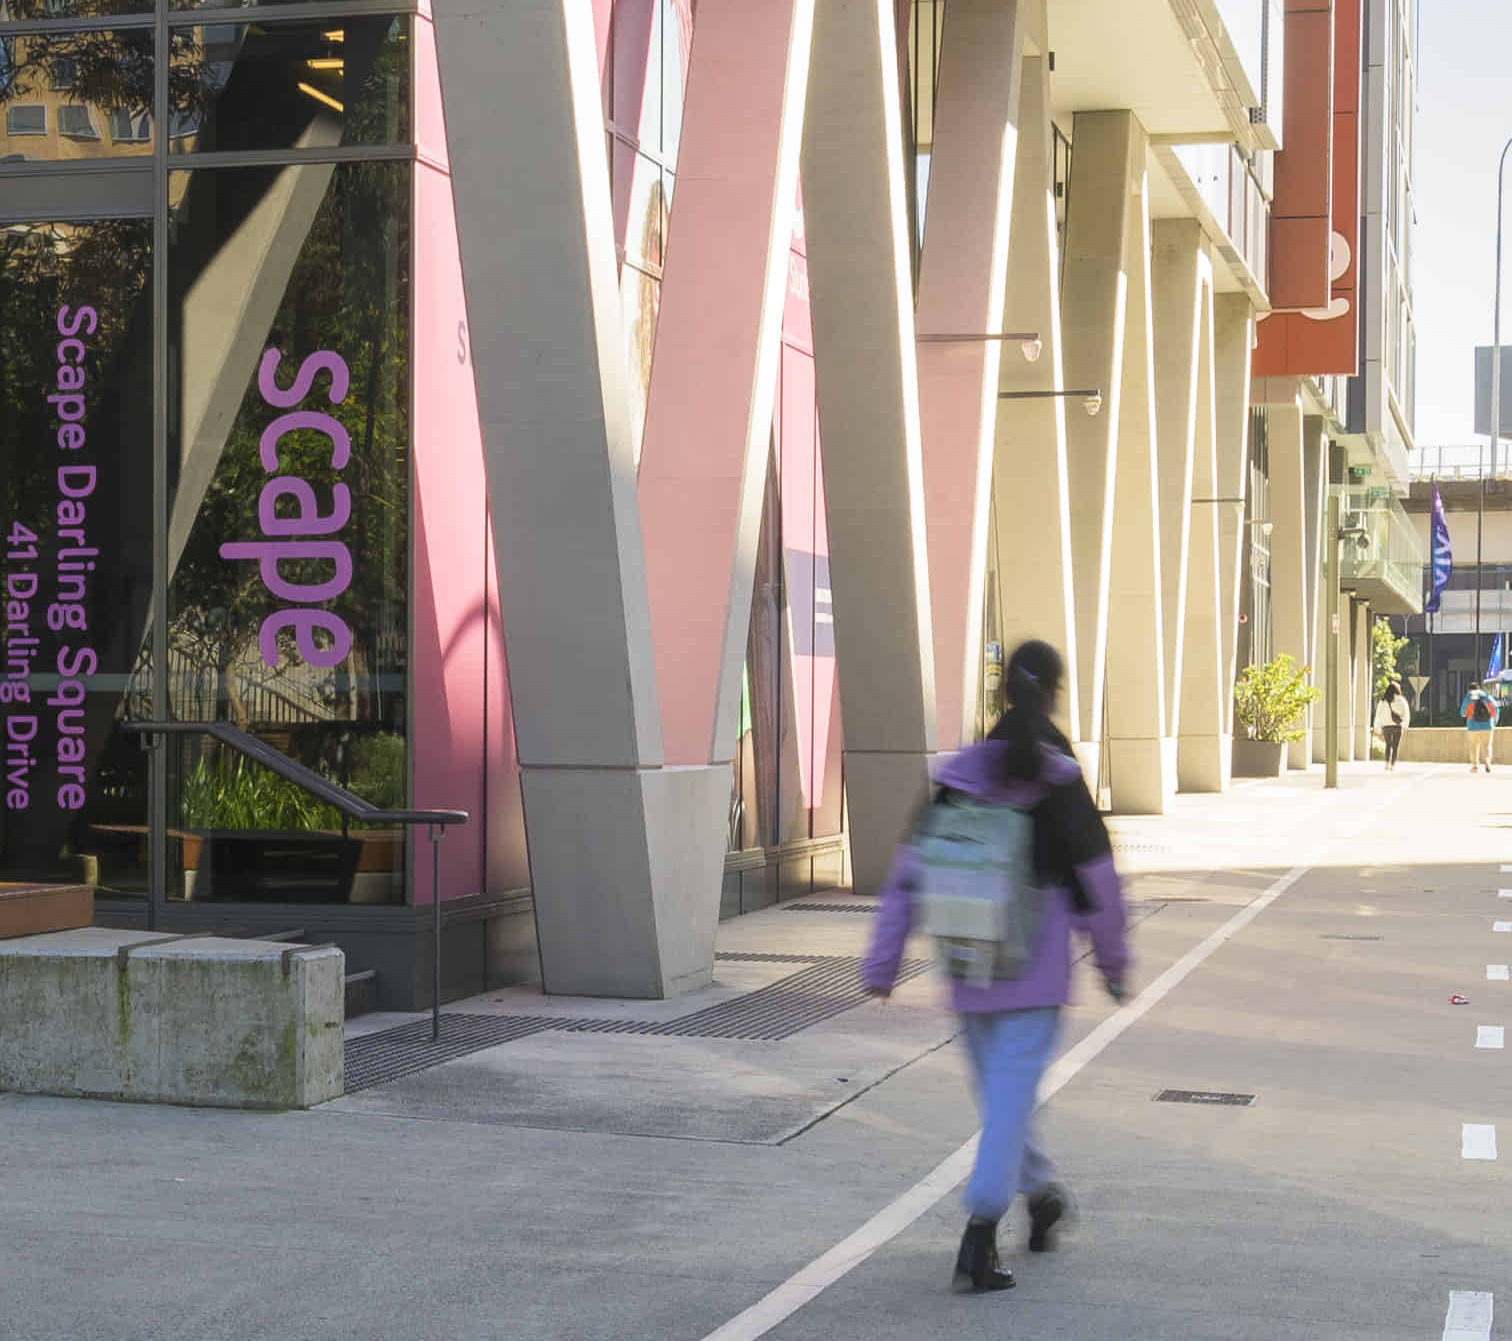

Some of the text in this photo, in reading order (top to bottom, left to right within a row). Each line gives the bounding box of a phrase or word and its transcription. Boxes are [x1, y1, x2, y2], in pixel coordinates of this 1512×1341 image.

[0, 521, 41, 809] 41 Darling Drive
[47, 304, 100, 810] Scape Darling Square
[219, 348, 353, 667] scape
